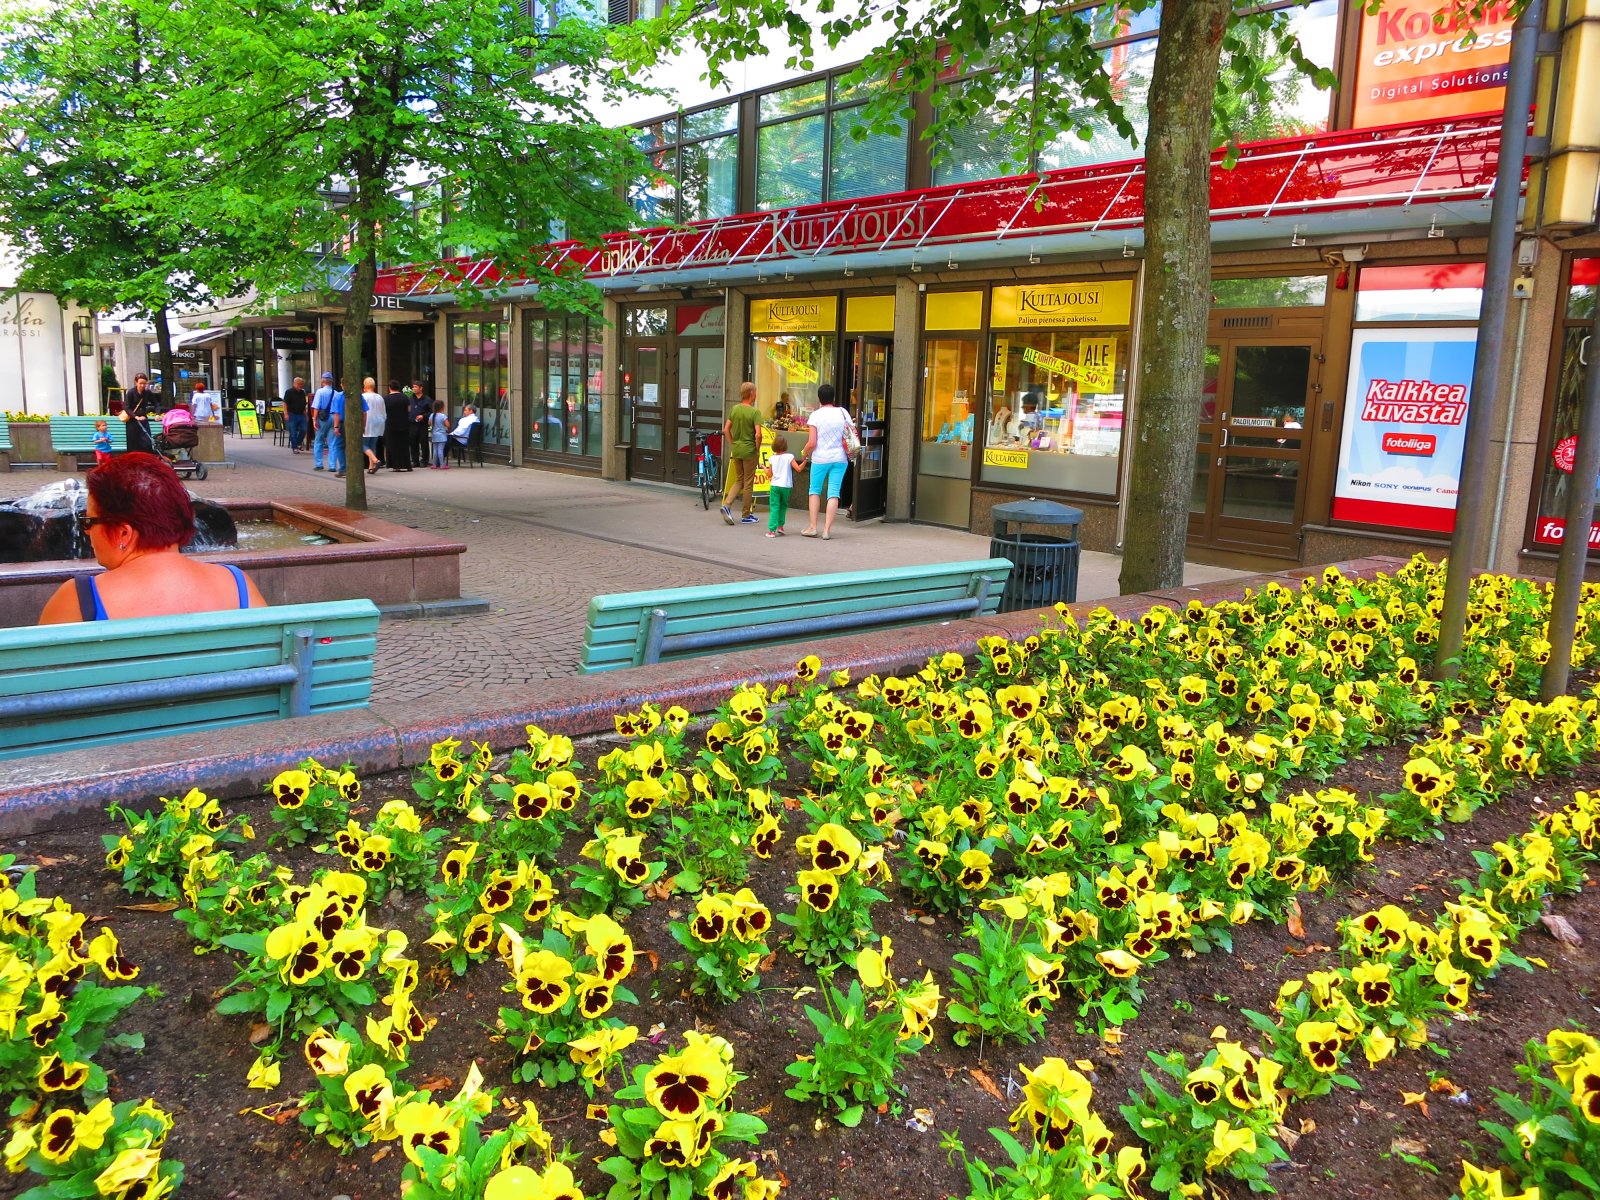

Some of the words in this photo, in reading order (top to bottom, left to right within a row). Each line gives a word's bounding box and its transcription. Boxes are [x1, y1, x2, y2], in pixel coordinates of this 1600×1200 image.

[1373, 29, 1512, 67] express
[1370, 81, 1424, 101] Digital
[1431, 71, 1509, 91] Solutions
[770, 207, 926, 258] KULTAJOUSI
[370, 295, 404, 309] OTEL
[1020, 290, 1099, 313] KULTAJOUSI
[701, 311, 725, 328] Emili
[769, 303, 819, 321] KULTAJOUSI
[1018, 316, 1037, 325] Paljon
[1038, 316, 1066, 325] pienessä
[1066, 315, 1099, 325] paketissa.
[0, 329, 41, 337] RASSI
[791, 344, 806, 362] ALE
[1024, 348, 1039, 363] ALE
[1084, 344, 1110, 366] ALE
[1366, 379, 1467, 403] Kaikkea
[1362, 400, 1467, 424] kuvasta!
[1233, 418, 1273, 426] PALOILMOITIN
[1386, 437, 1432, 451] fotoliiga
[985, 451, 1026, 465] KULTAJOUSI
[1374, 482, 1400, 490] SONY
